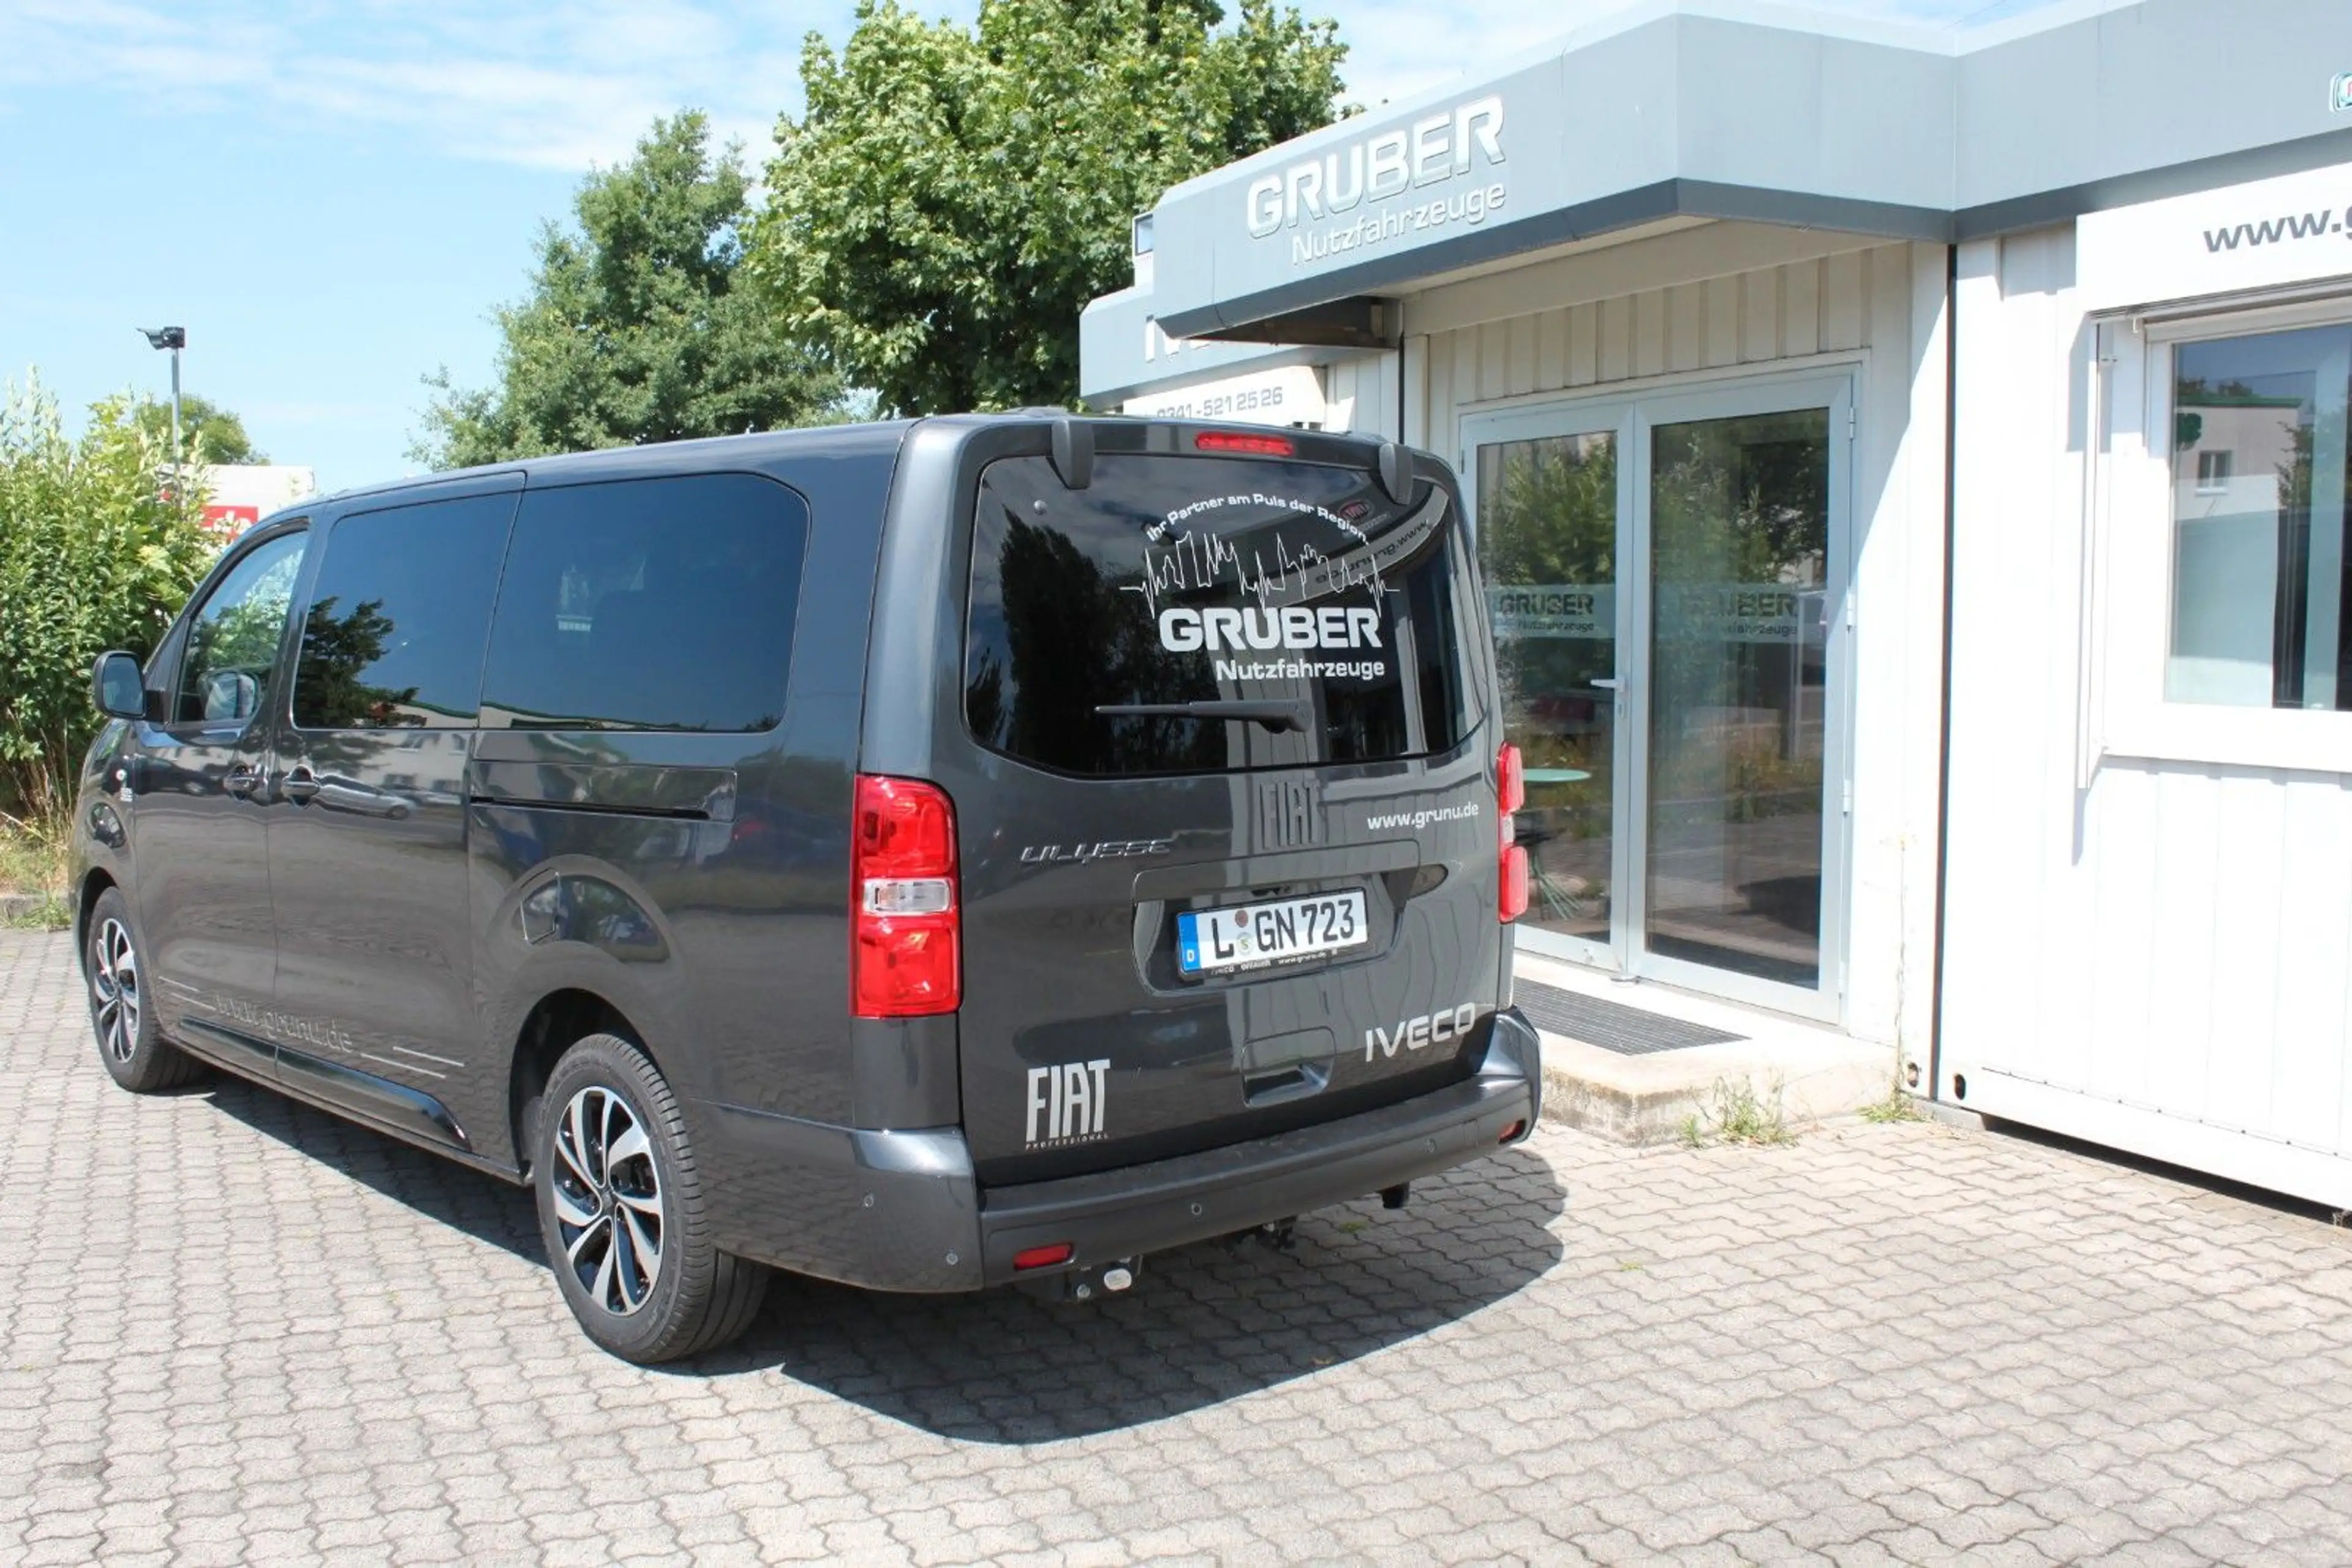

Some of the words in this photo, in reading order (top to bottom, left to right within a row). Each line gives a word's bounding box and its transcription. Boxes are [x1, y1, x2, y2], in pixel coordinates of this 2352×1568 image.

[1246, 94, 1506, 239] GRUBER
[1291, 180, 1506, 266] Nutzfahrzeuge
[1147, 520, 1167, 541] Ihr
[1167, 497, 1224, 525] Partner
[1227, 495, 1250, 505] am
[1253, 493, 1286, 508] Puls
[1289, 499, 1314, 513] der
[1159, 608, 1382, 652] GRUBER
[1499, 593, 1594, 615] GRUBER
[1216, 658, 1385, 680] Nutzfahrzeuge
[1259, 779, 1321, 850] FIAT
[1367, 801, 1479, 829] www.grunu.de
[1212, 918, 1234, 959] L
[1255, 907, 1297, 952] GN
[1301, 899, 1355, 946] 723
[1365, 1001, 1476, 1063] IVECO
[1025, 1058, 1111, 1142] FIAT
[1025, 1133, 1110, 1151] PROFESSIONAL
